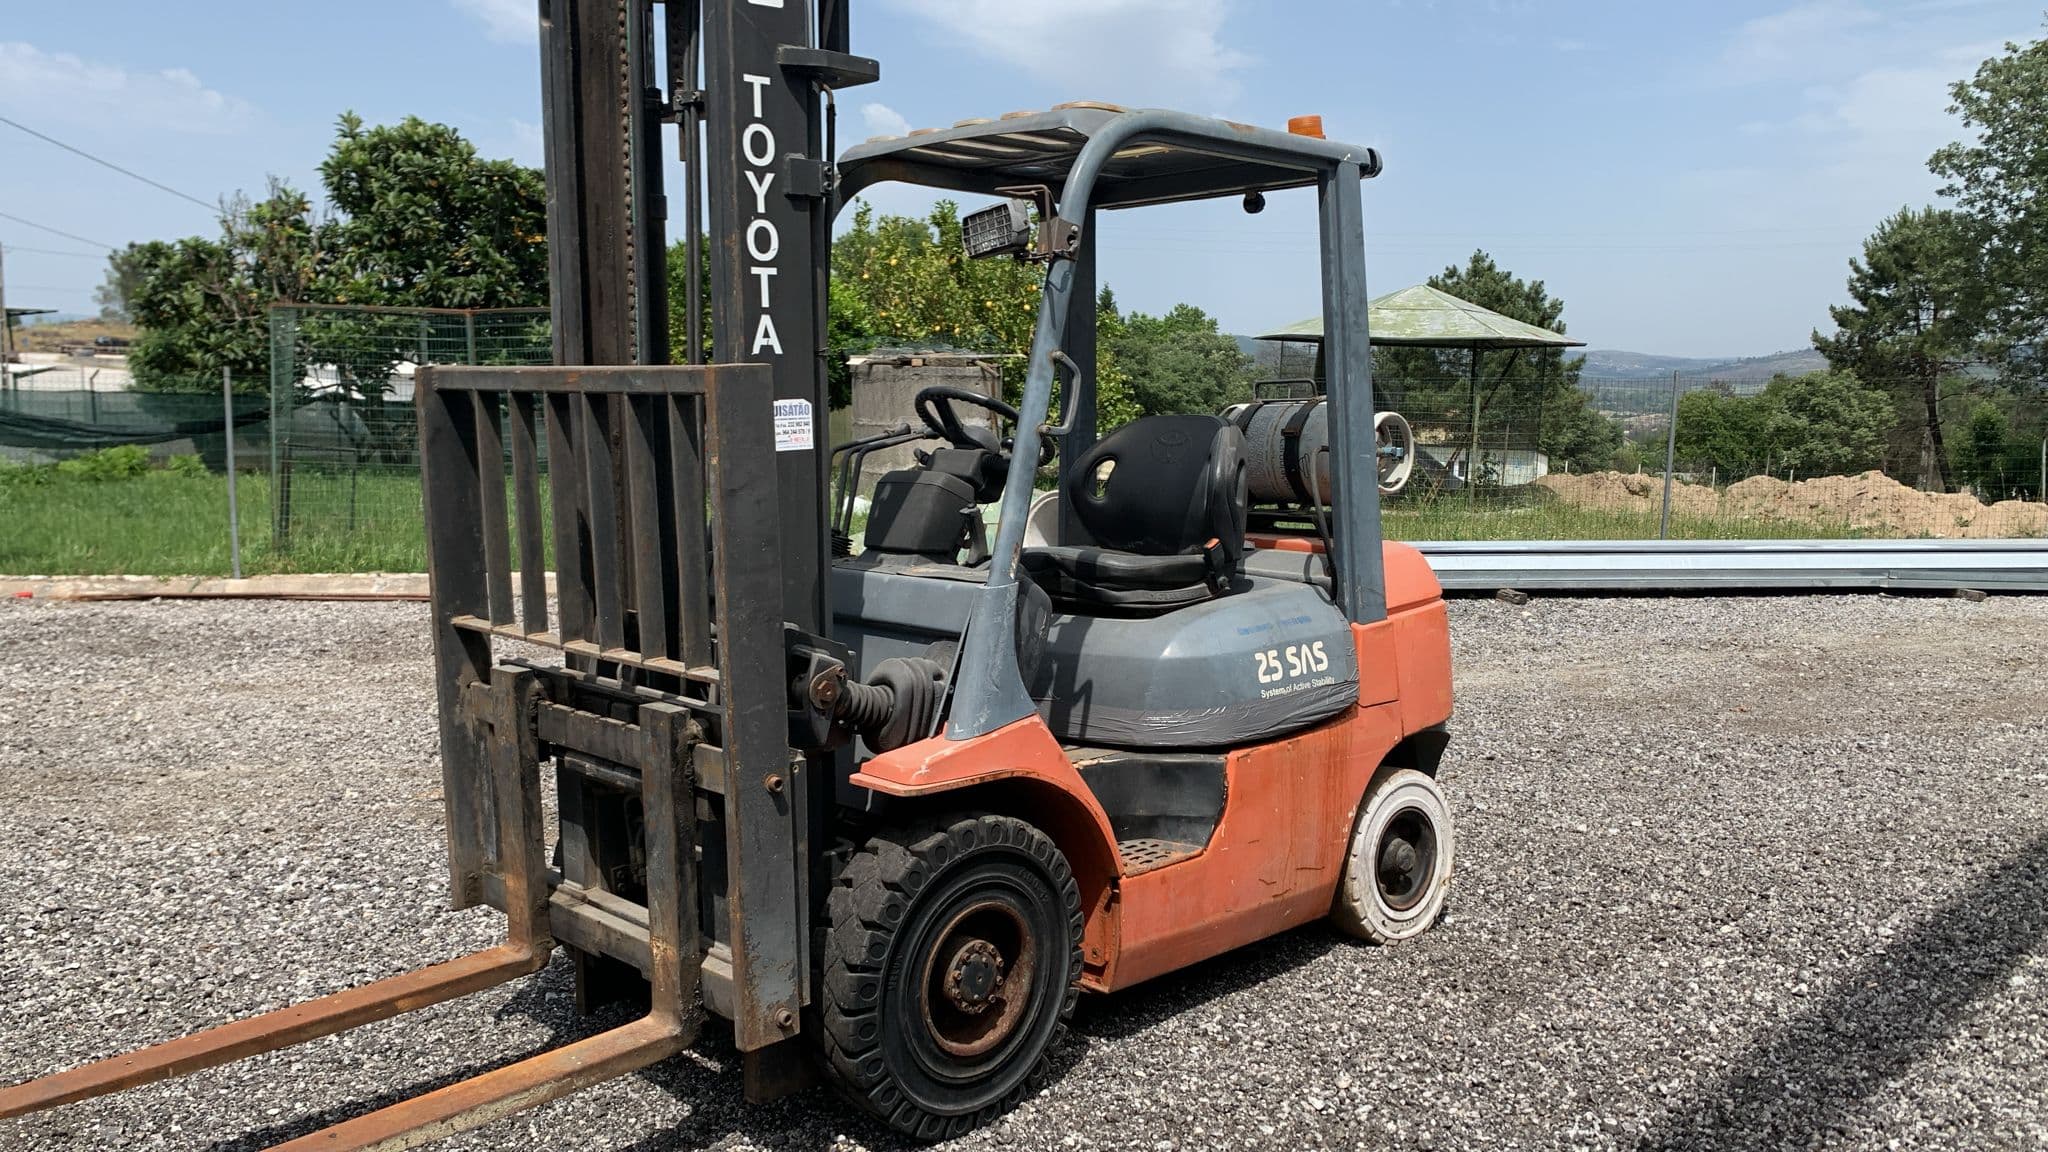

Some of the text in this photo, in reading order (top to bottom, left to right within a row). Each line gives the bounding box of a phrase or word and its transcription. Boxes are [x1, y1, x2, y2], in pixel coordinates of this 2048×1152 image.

[742, 73, 784, 356] TOYOTA
[1254, 640, 1329, 684] 25 SAS
[1261, 687, 1286, 699] System
[1293, 682, 1312, 691] Active
[1311, 675, 1335, 688] Stability
